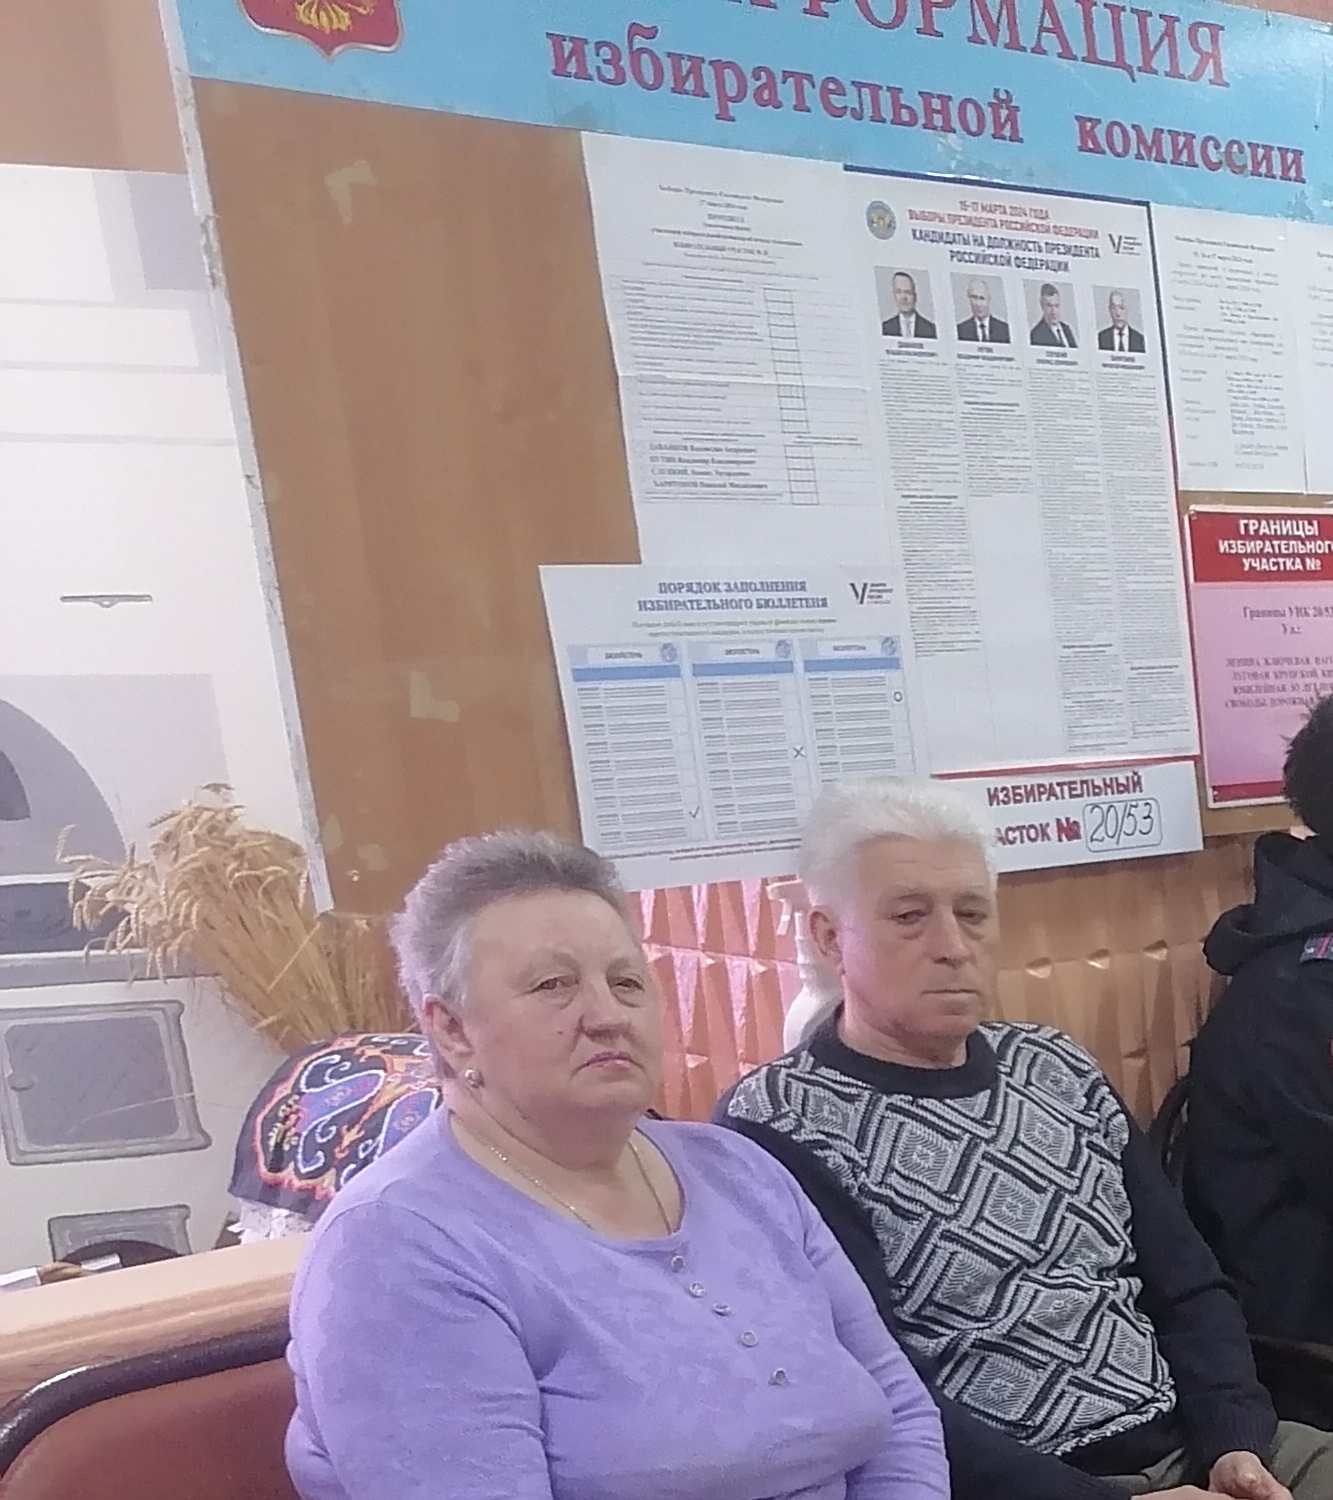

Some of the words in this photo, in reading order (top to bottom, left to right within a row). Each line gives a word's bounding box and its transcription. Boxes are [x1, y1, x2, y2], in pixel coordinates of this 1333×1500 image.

[546, 22, 1024, 144] избирательной
[1075, 114, 1306, 184] комиссии
[911, 228, 970, 246] КАНДИДАТЫ
[986, 236, 1043, 253] ДОЛЖНОСТЬ
[949, 250, 1012, 269] РОССИЙСКОЙ
[1239, 519, 1319, 538] ГРАНИЦЫ
[1242, 557, 1303, 573] УЧАСТКА
[1306, 557, 1321, 571] №
[658, 581, 721, 595] ПОРЯДОК
[723, 580, 807, 594] ЗАПОЛНЕНИЯ
[637, 598, 753, 612] ИЗБИРАТЕЛЬНОГО
[756, 597, 828, 610] БЮЛЛЕТЕНЯ
[987, 771, 1144, 807] ИЗБИРАТЕЛЬНЫЙ
[994, 822, 1051, 846] АСТОК
[1056, 817, 1082, 843] №
[1089, 801, 1155, 846] 20/53
